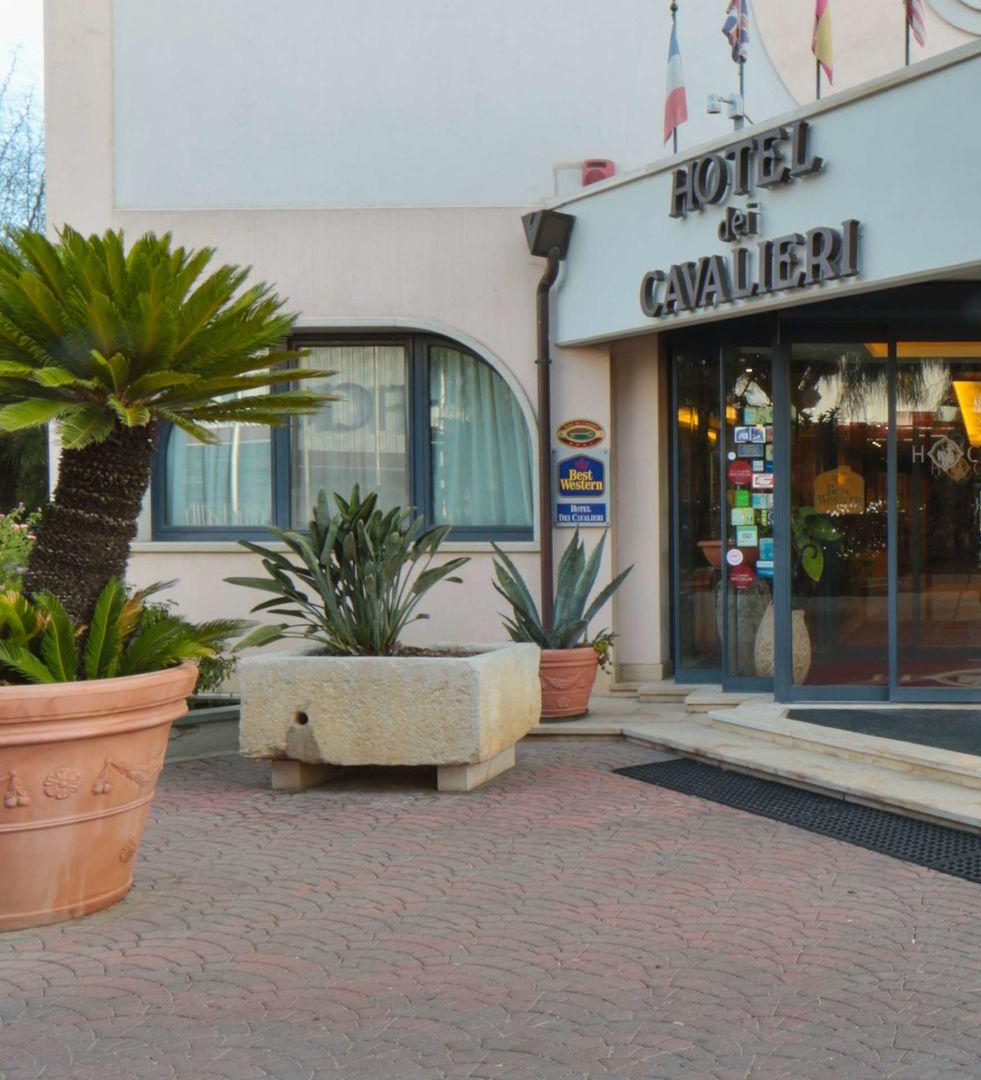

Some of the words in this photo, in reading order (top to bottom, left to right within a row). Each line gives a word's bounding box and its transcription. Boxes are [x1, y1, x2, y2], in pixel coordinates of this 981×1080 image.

[669, 120, 824, 218] HOTEL
[718, 201, 761, 242] dei
[640, 218, 860, 317] CAVALIERI
[560, 479, 603, 491] Western
[569, 469, 593, 481] Best
